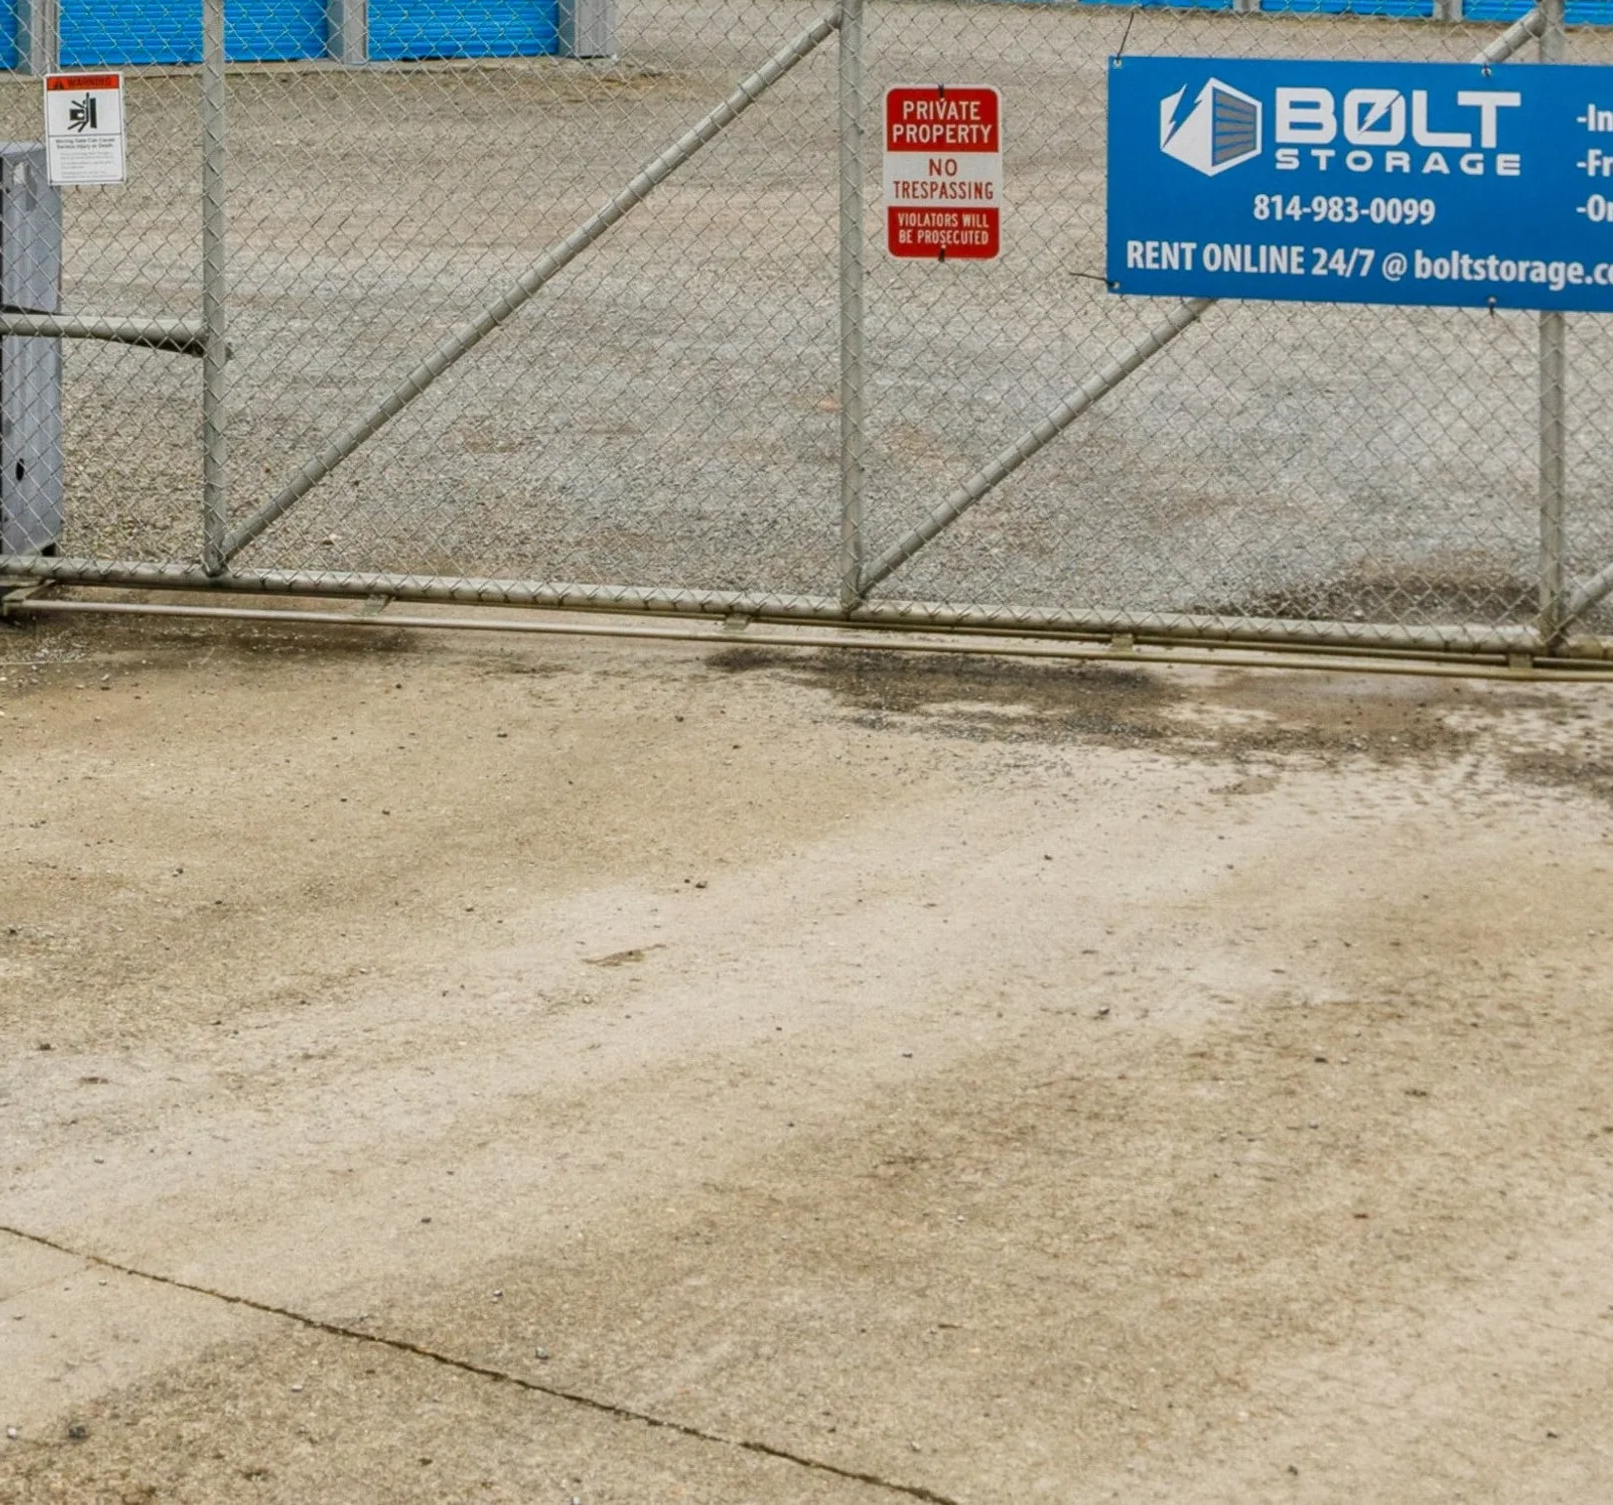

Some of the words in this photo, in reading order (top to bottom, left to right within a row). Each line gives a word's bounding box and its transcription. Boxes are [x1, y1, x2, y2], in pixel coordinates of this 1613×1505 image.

[902, 100, 981, 121] PRIVATE
[1275, 87, 1521, 148] BOLT
[892, 123, 993, 144] PROPERTY
[928, 158, 958, 177] NO
[1275, 148, 1521, 176] STORAGE
[893, 180, 994, 200] TRESPASSING
[897, 212, 959, 228] VIOLATORS
[961, 213, 990, 228] WILL
[1253, 194, 1436, 226] 814-983-0099
[898, 229, 913, 244] BE
[917, 229, 990, 245] PROSECUTED
[1126, 239, 1197, 270] RENT
[1203, 243, 1304, 274] ONLINE
[1311, 247, 1375, 278] 24/7
[1382, 252, 1407, 281] @
